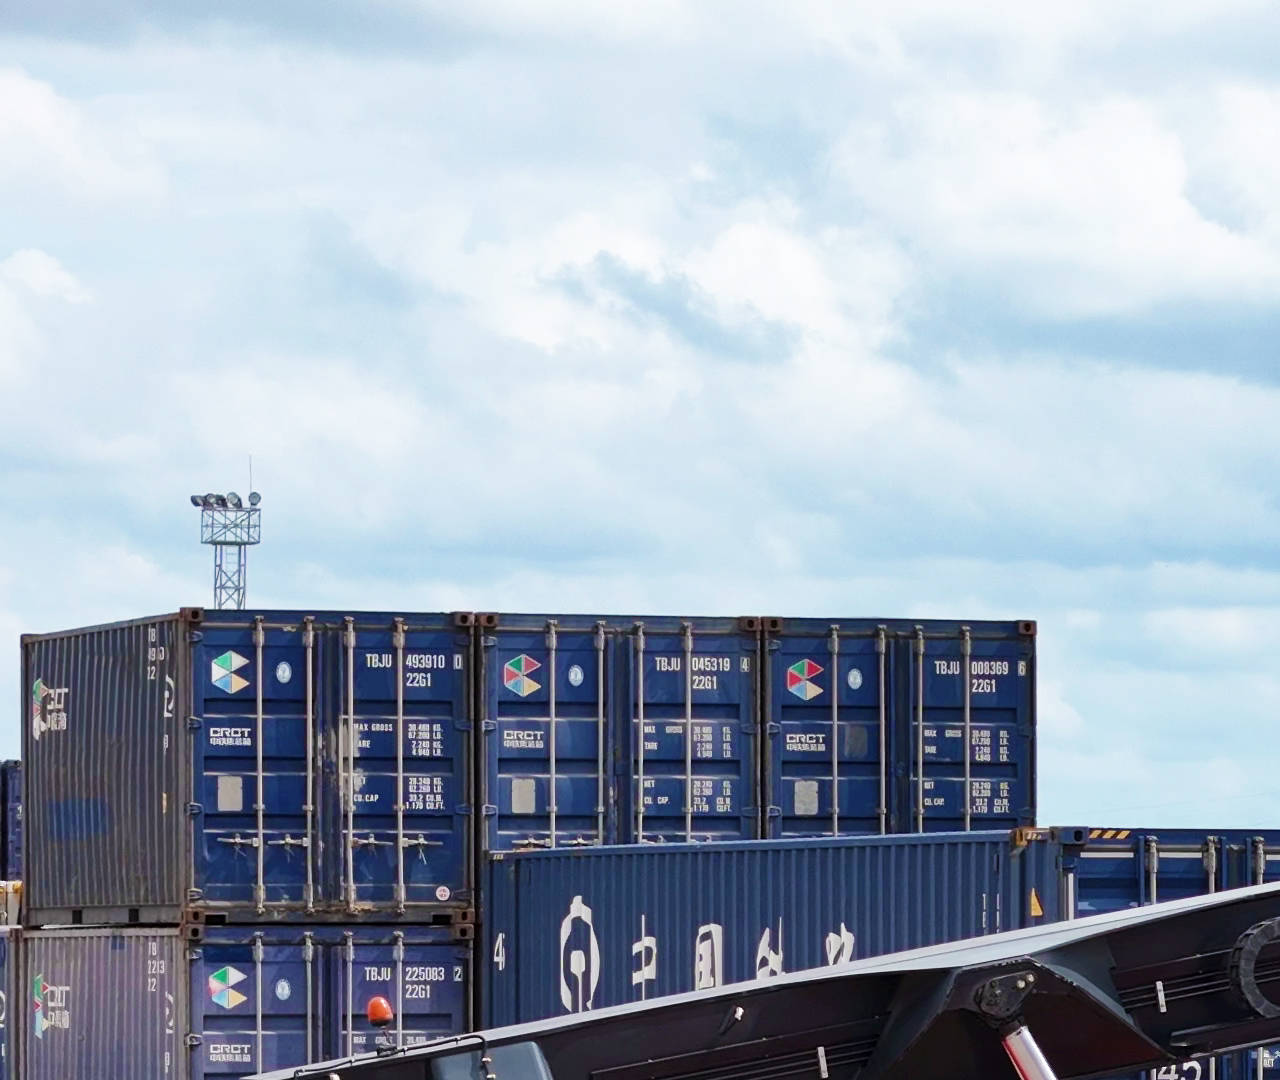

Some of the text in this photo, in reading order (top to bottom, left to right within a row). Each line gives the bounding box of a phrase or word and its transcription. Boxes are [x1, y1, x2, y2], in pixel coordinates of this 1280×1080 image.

[365, 653, 392, 668] TBJU
[405, 654, 446, 669] 493910
[655, 657, 681, 672] TBJU
[691, 657, 731, 672] 045319
[934, 660, 960, 675] TBJU
[971, 660, 1009, 675] 008369
[405, 673, 432, 687] 22G1
[692, 675, 718, 689] 22G1
[972, 678, 996, 693] 22G1
[364, 967, 391, 981] TBJU
[405, 967, 445, 981] 225083
[405, 984, 431, 998] 22G1
